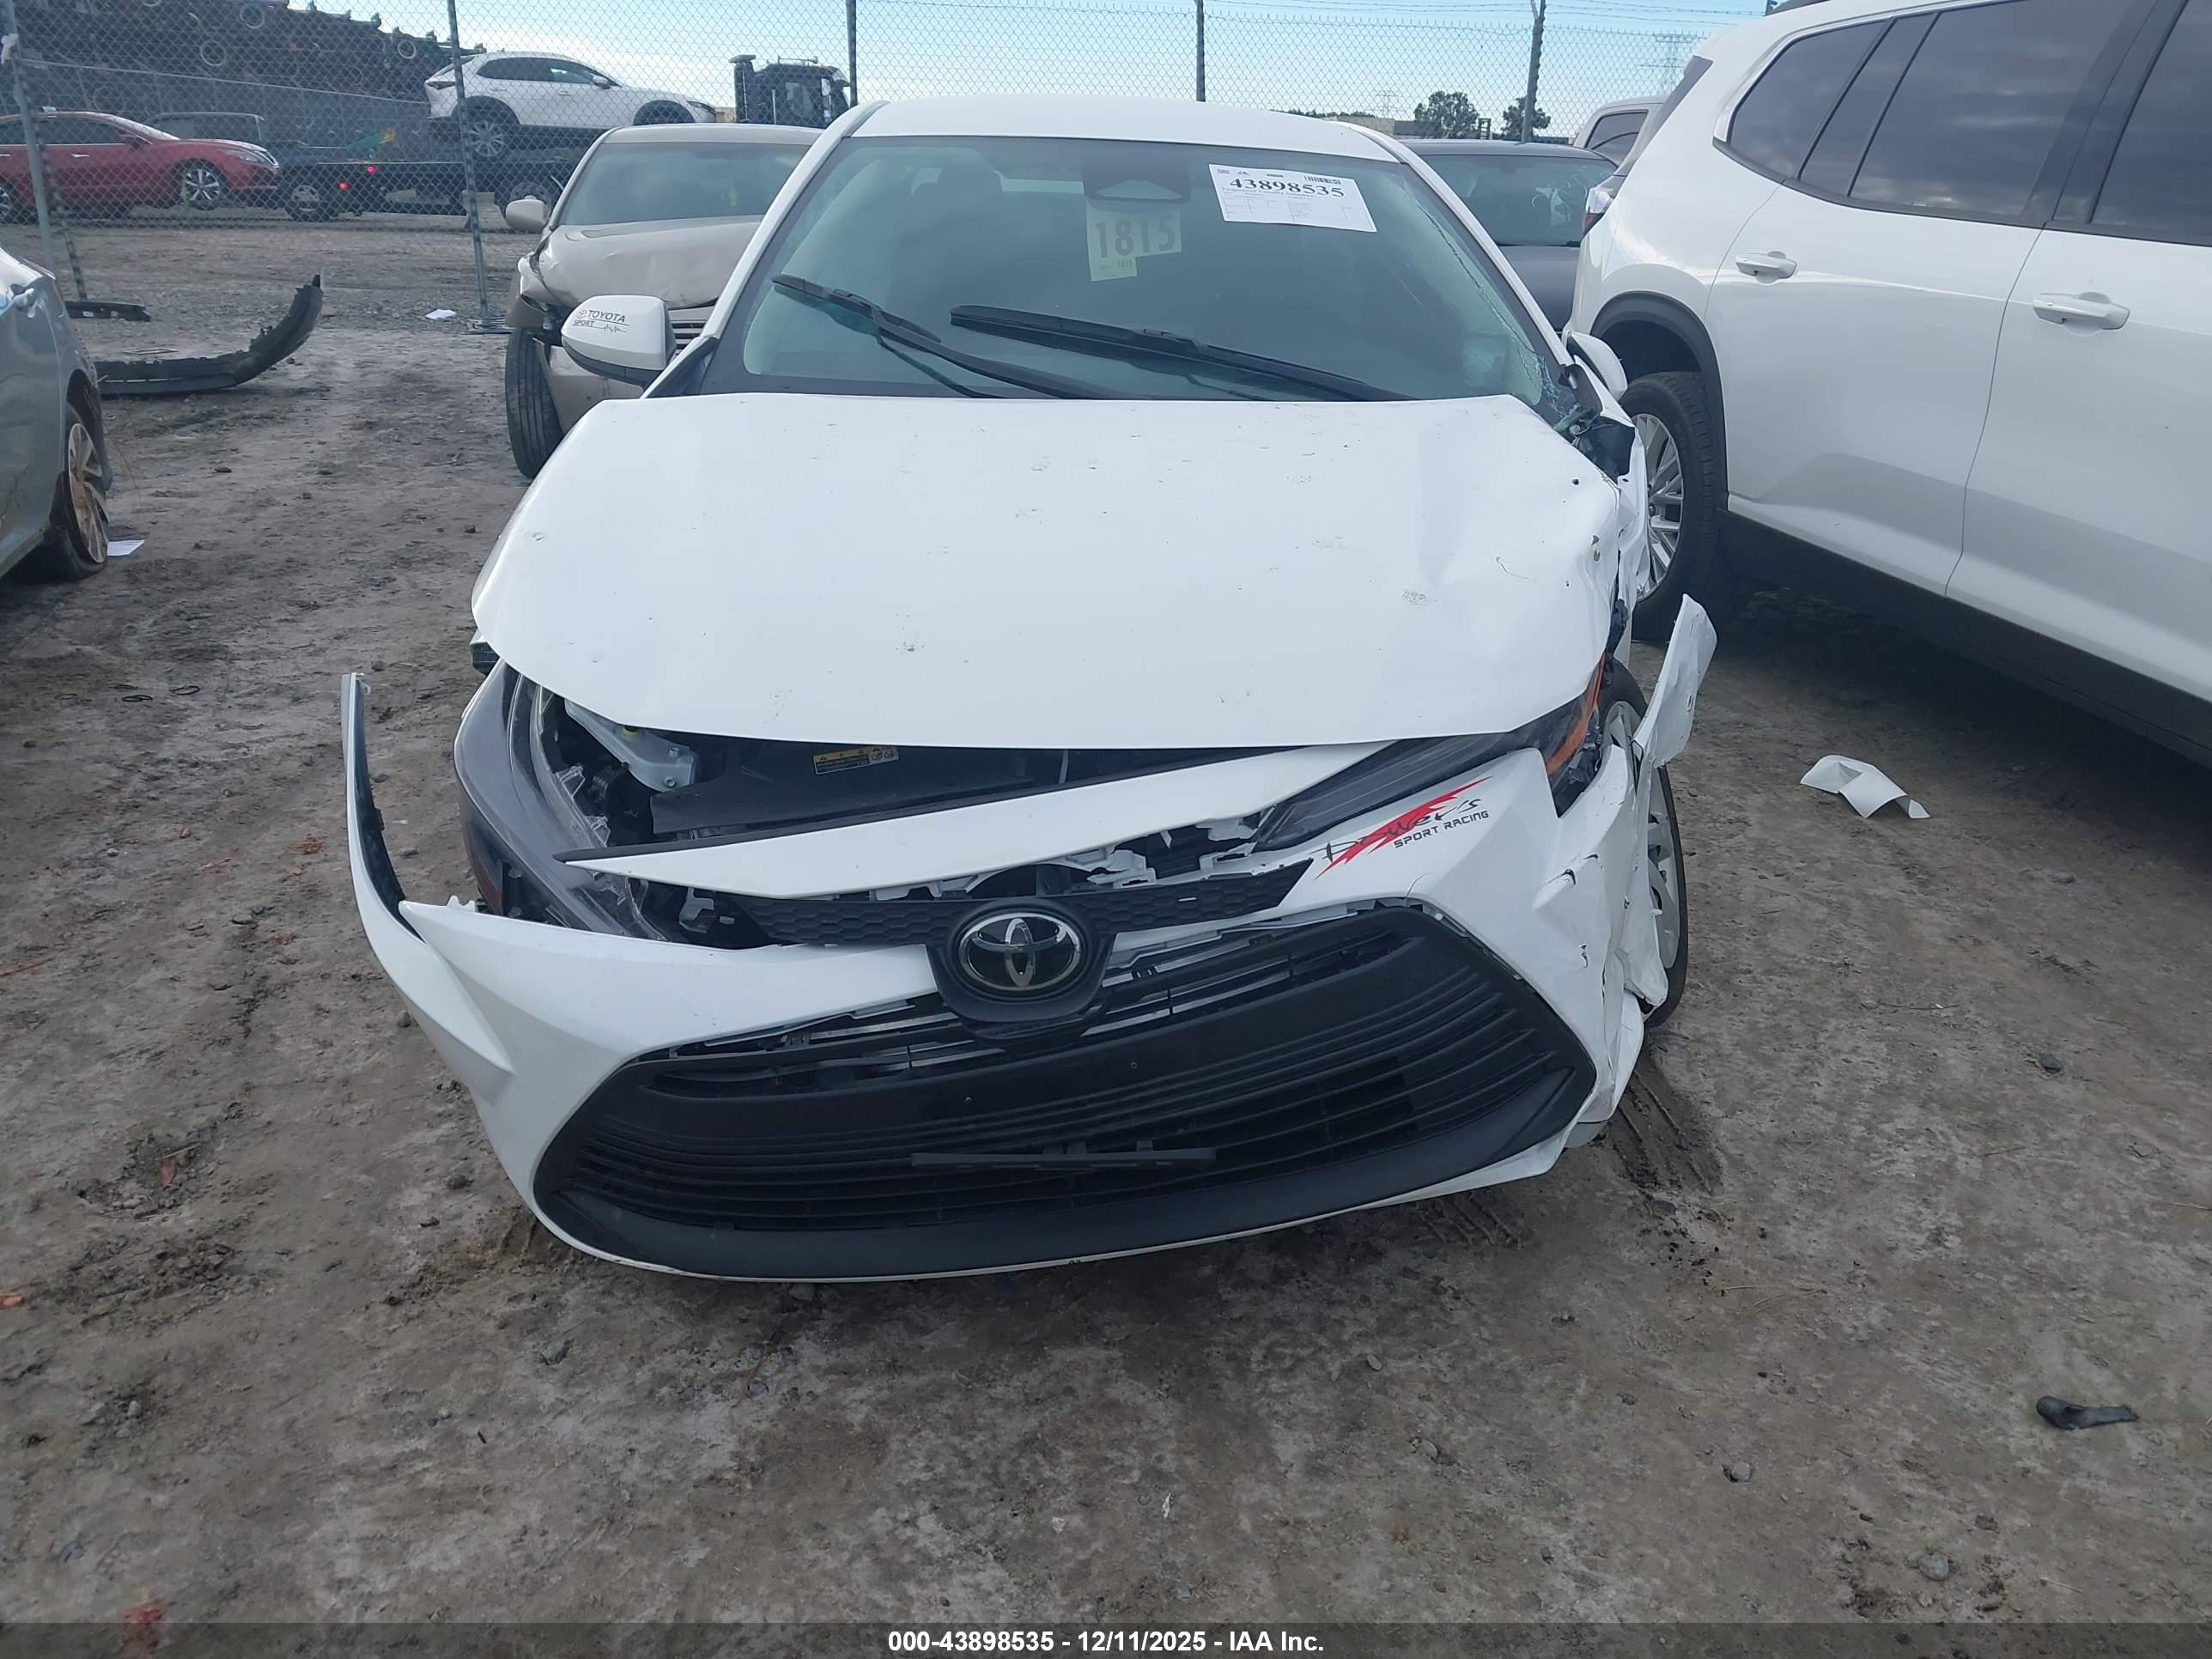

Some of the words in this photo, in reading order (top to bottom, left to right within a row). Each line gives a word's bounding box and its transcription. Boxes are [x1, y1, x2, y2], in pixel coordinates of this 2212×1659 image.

[1230, 178, 1346, 198] 43898535
[1095, 214, 1176, 258] 1815
[589, 310, 626, 323] TOYOTA
[1393, 825, 1440, 848] SPORT
[1443, 810, 1491, 830] RACING
